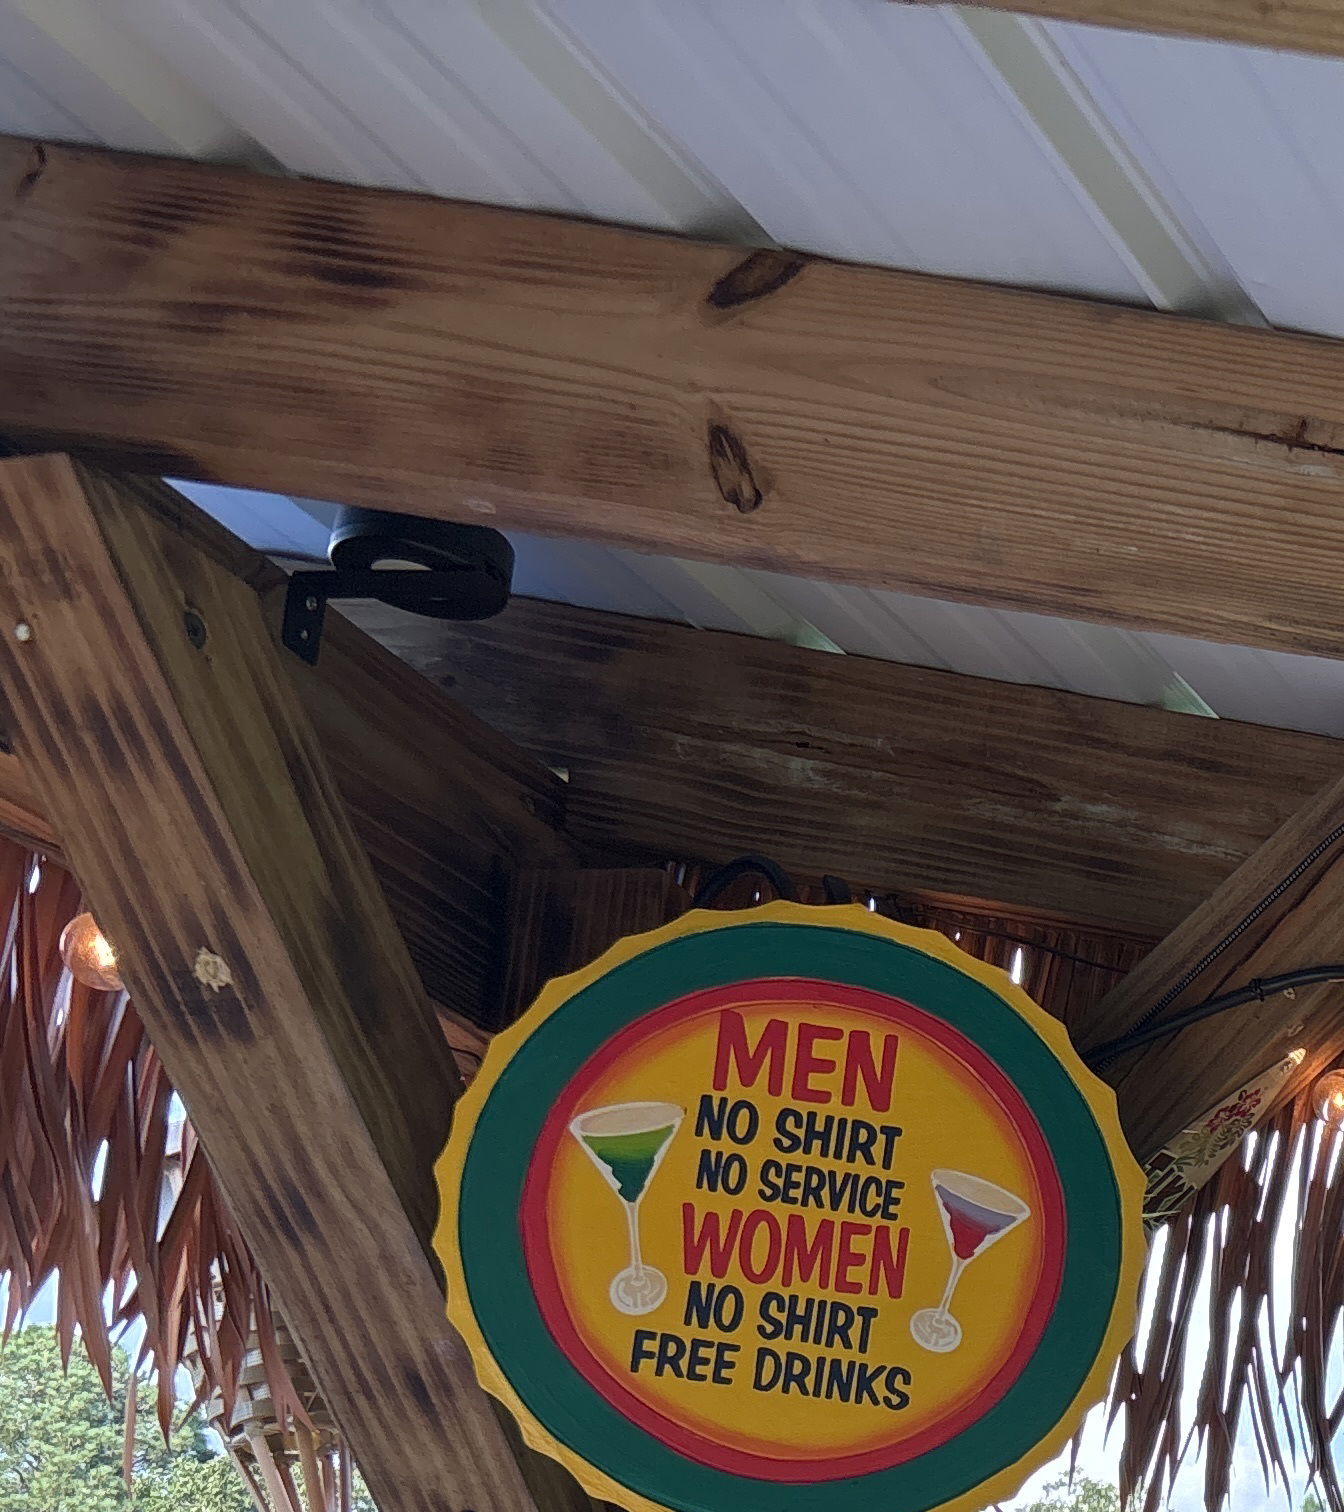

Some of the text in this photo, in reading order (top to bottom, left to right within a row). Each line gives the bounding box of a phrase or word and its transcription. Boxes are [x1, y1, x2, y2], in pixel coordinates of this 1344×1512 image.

[712, 1009, 899, 1113] MEN
[695, 1094, 903, 1171] NO SHIRT
[695, 1148, 905, 1221] NO SERVICE
[681, 1202, 911, 1299] WOMEN
[683, 1280, 879, 1354] NO SHIRT
[629, 1329, 912, 1411] FREE DRINKS
